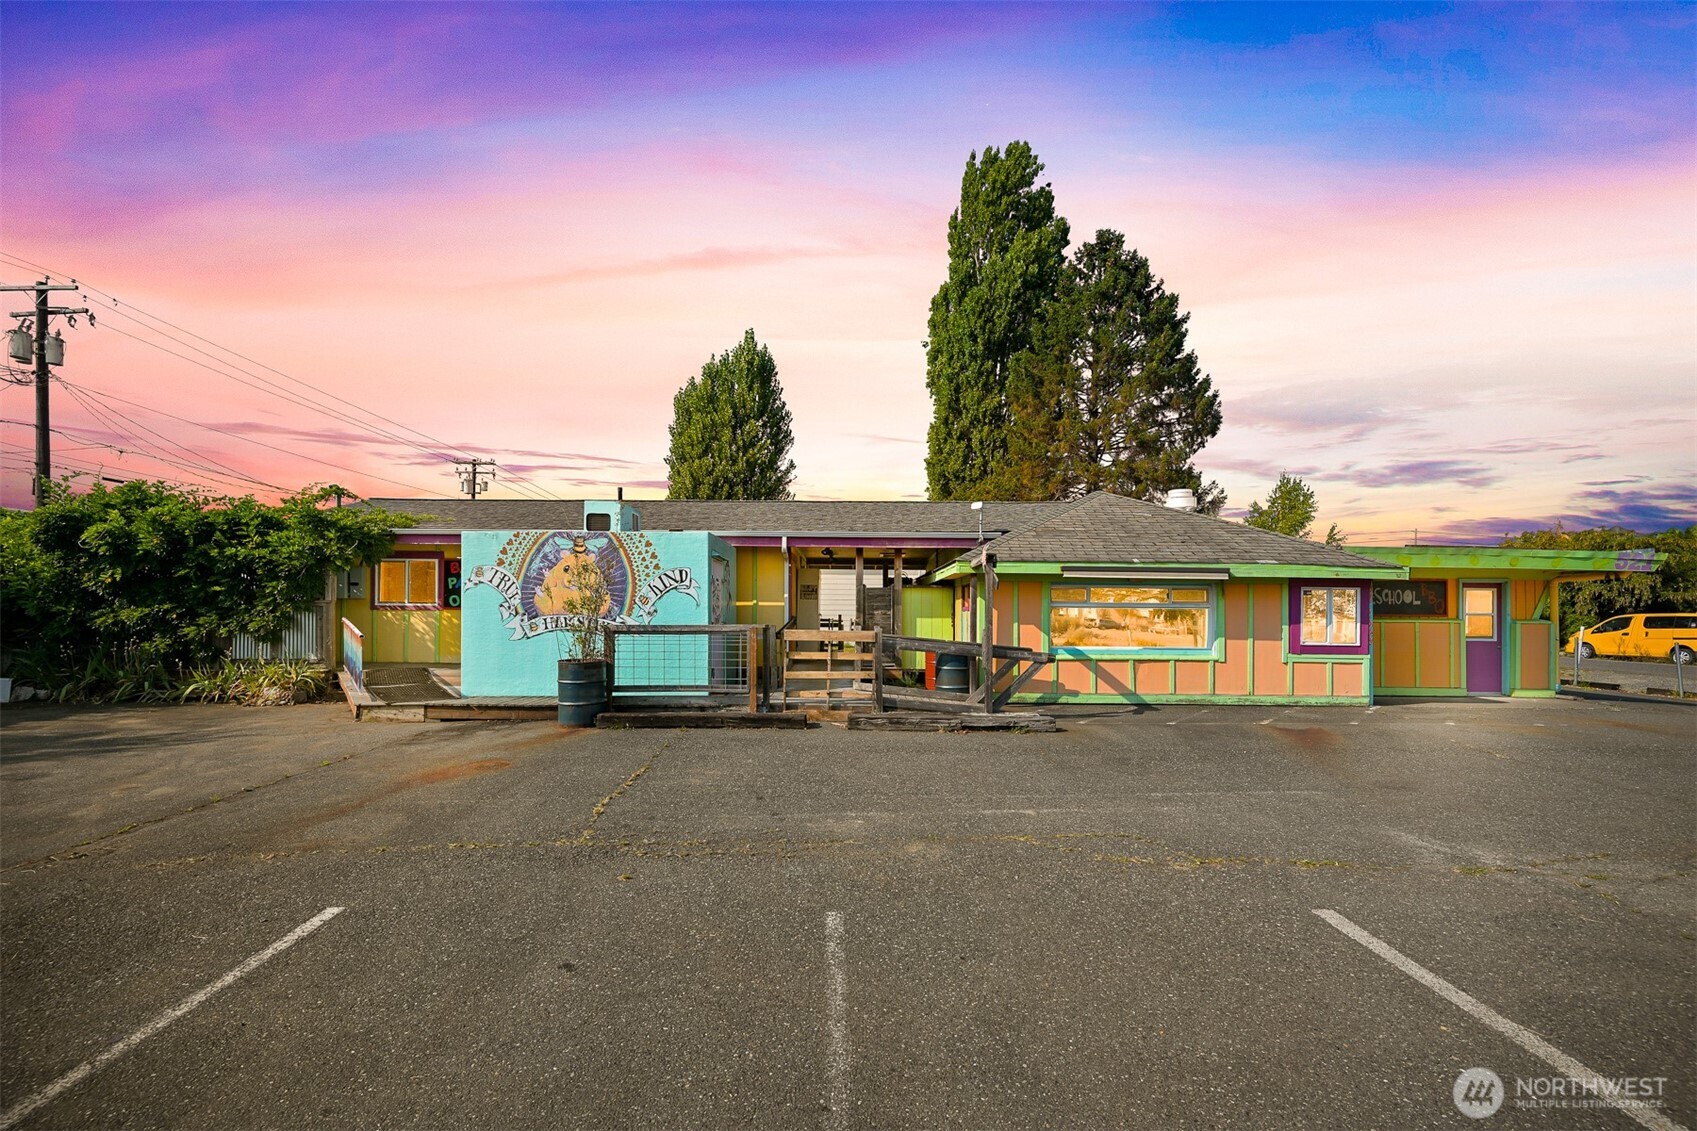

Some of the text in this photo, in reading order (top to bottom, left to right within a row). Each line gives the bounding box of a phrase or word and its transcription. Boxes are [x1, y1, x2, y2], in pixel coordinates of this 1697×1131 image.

[1615, 551, 1655, 571] 521
[488, 567, 521, 606] TRUE
[647, 568, 689, 597] KIND
